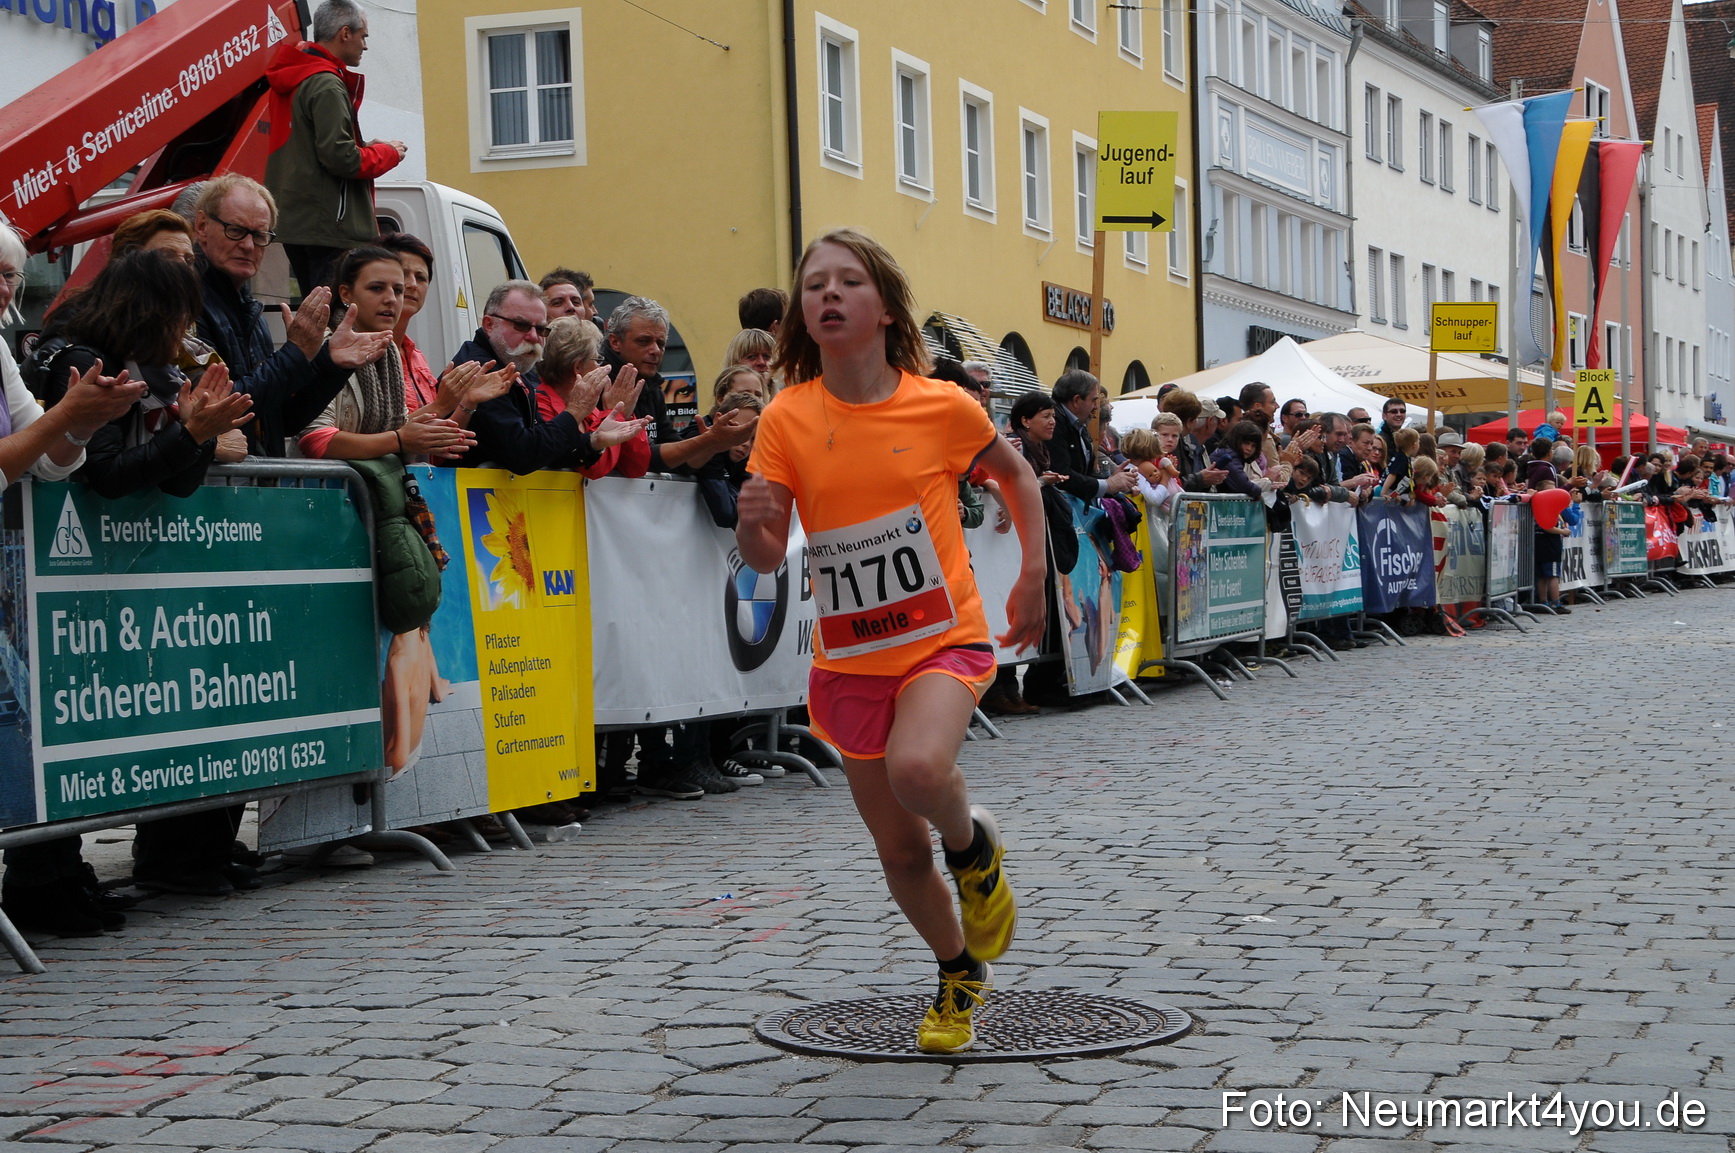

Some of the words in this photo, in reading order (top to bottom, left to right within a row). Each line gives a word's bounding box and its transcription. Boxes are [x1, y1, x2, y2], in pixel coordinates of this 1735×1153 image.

[12, 160, 63, 208] Miet-
[66, 145, 82, 174] &
[178, 49, 223, 98] 09181
[223, 24, 261, 68] 6352
[1100, 143, 1174, 166] Jugend-
[1119, 166, 1154, 185] lauf
[1435, 316, 1492, 329] Schnupper-
[1453, 330, 1473, 341] lauf
[1579, 370, 1610, 383] Block
[1582, 386, 1605, 414] A
[100, 514, 263, 549] Event-Leit-Systeme
[836, 527, 902, 554] Neumarkt
[818, 545, 925, 611] 7170
[51, 608, 108, 656] Fun
[118, 605, 143, 652] &
[150, 601, 241, 649] Action
[248, 600, 272, 642] in
[851, 611, 909, 639] Merle
[485, 633, 521, 650] Pflaster
[488, 656, 552, 678] Außenplatten
[54, 672, 181, 725] sicheren
[190, 660, 297, 711] Bahnen!
[491, 683, 537, 702] Palisaden
[494, 711, 526, 729] Stufen
[496, 732, 566, 756] Gartenmauern
[60, 771, 105, 803] Miet
[111, 767, 127, 796] &
[131, 760, 194, 793] Service
[199, 753, 238, 783] Line:
[241, 744, 287, 777] 09181
[291, 740, 326, 768] 6352
